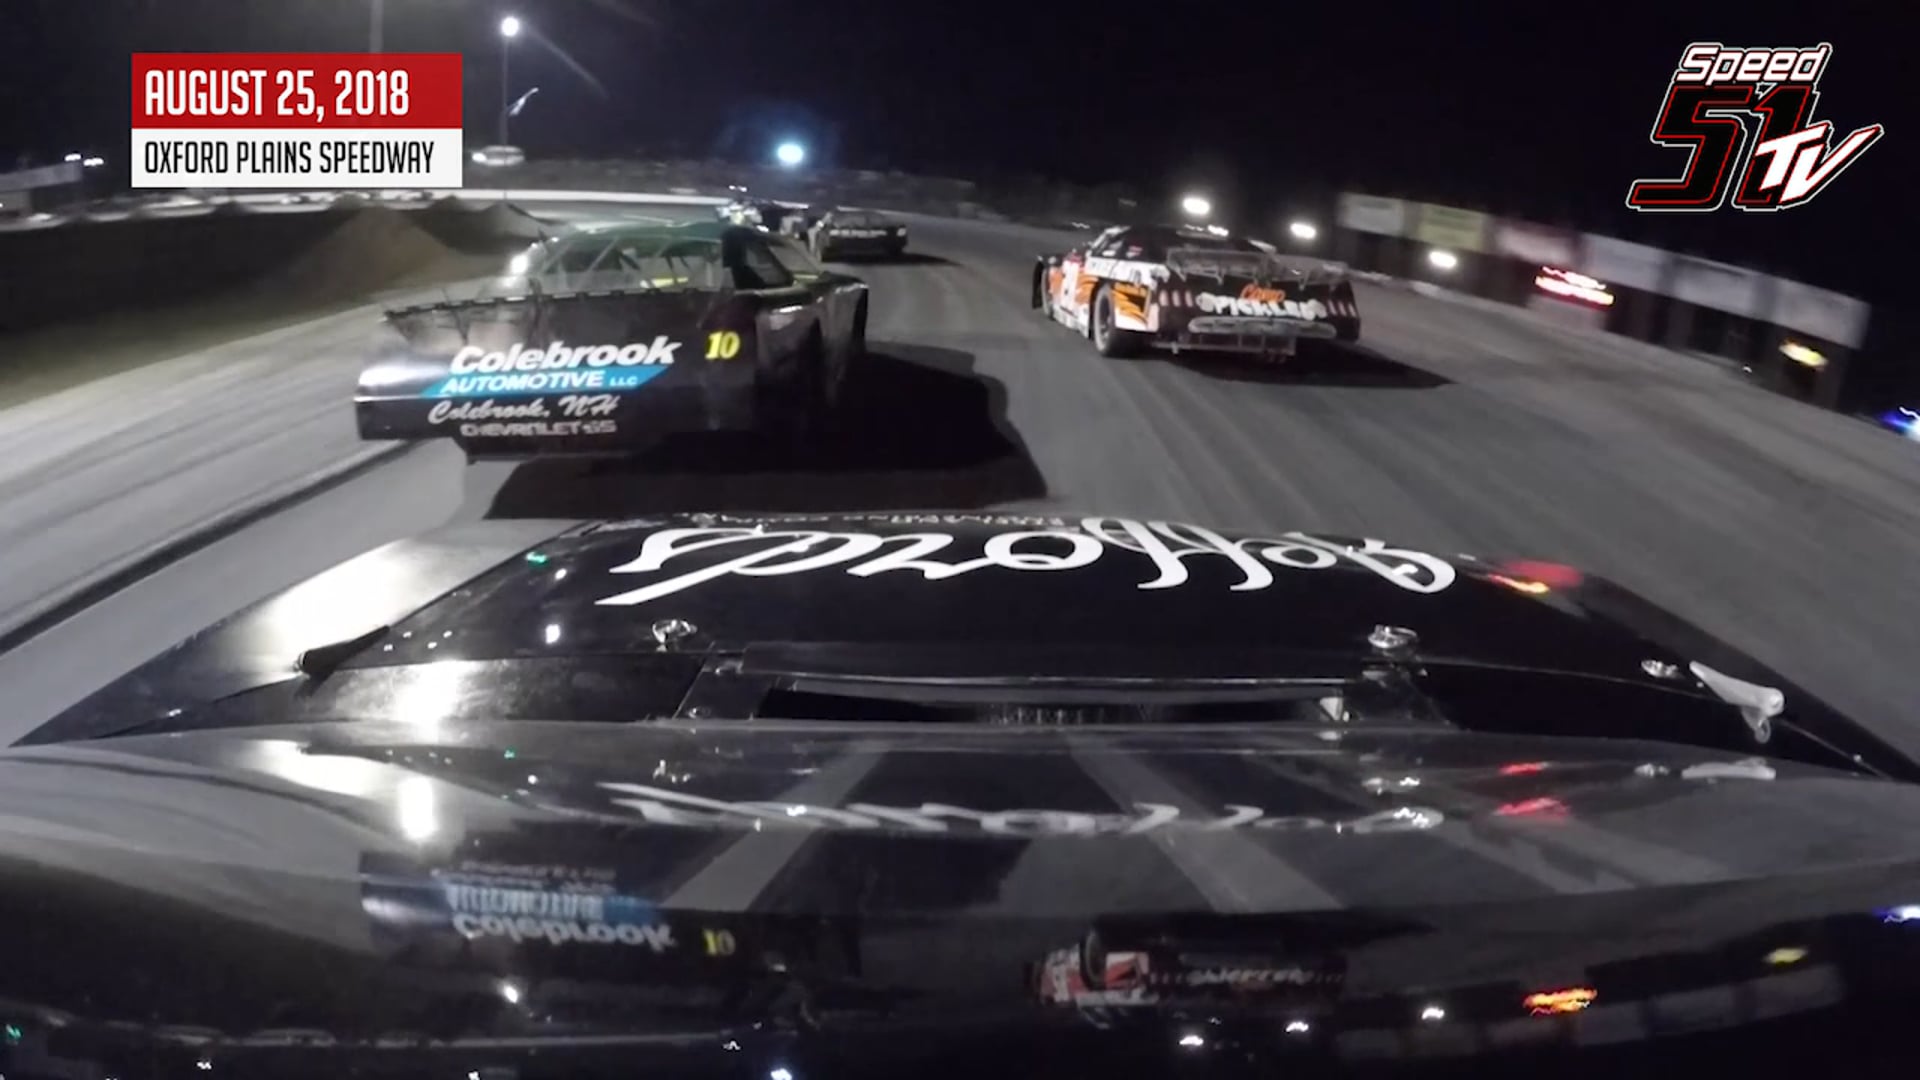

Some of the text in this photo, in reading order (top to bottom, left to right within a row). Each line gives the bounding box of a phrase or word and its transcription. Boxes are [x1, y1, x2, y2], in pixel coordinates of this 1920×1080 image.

[452, 336, 681, 373] Colebrook
[706, 332, 739, 359] 10
[442, 370, 603, 394] AUTOMOTIVE
[559, 394, 620, 416] NH
